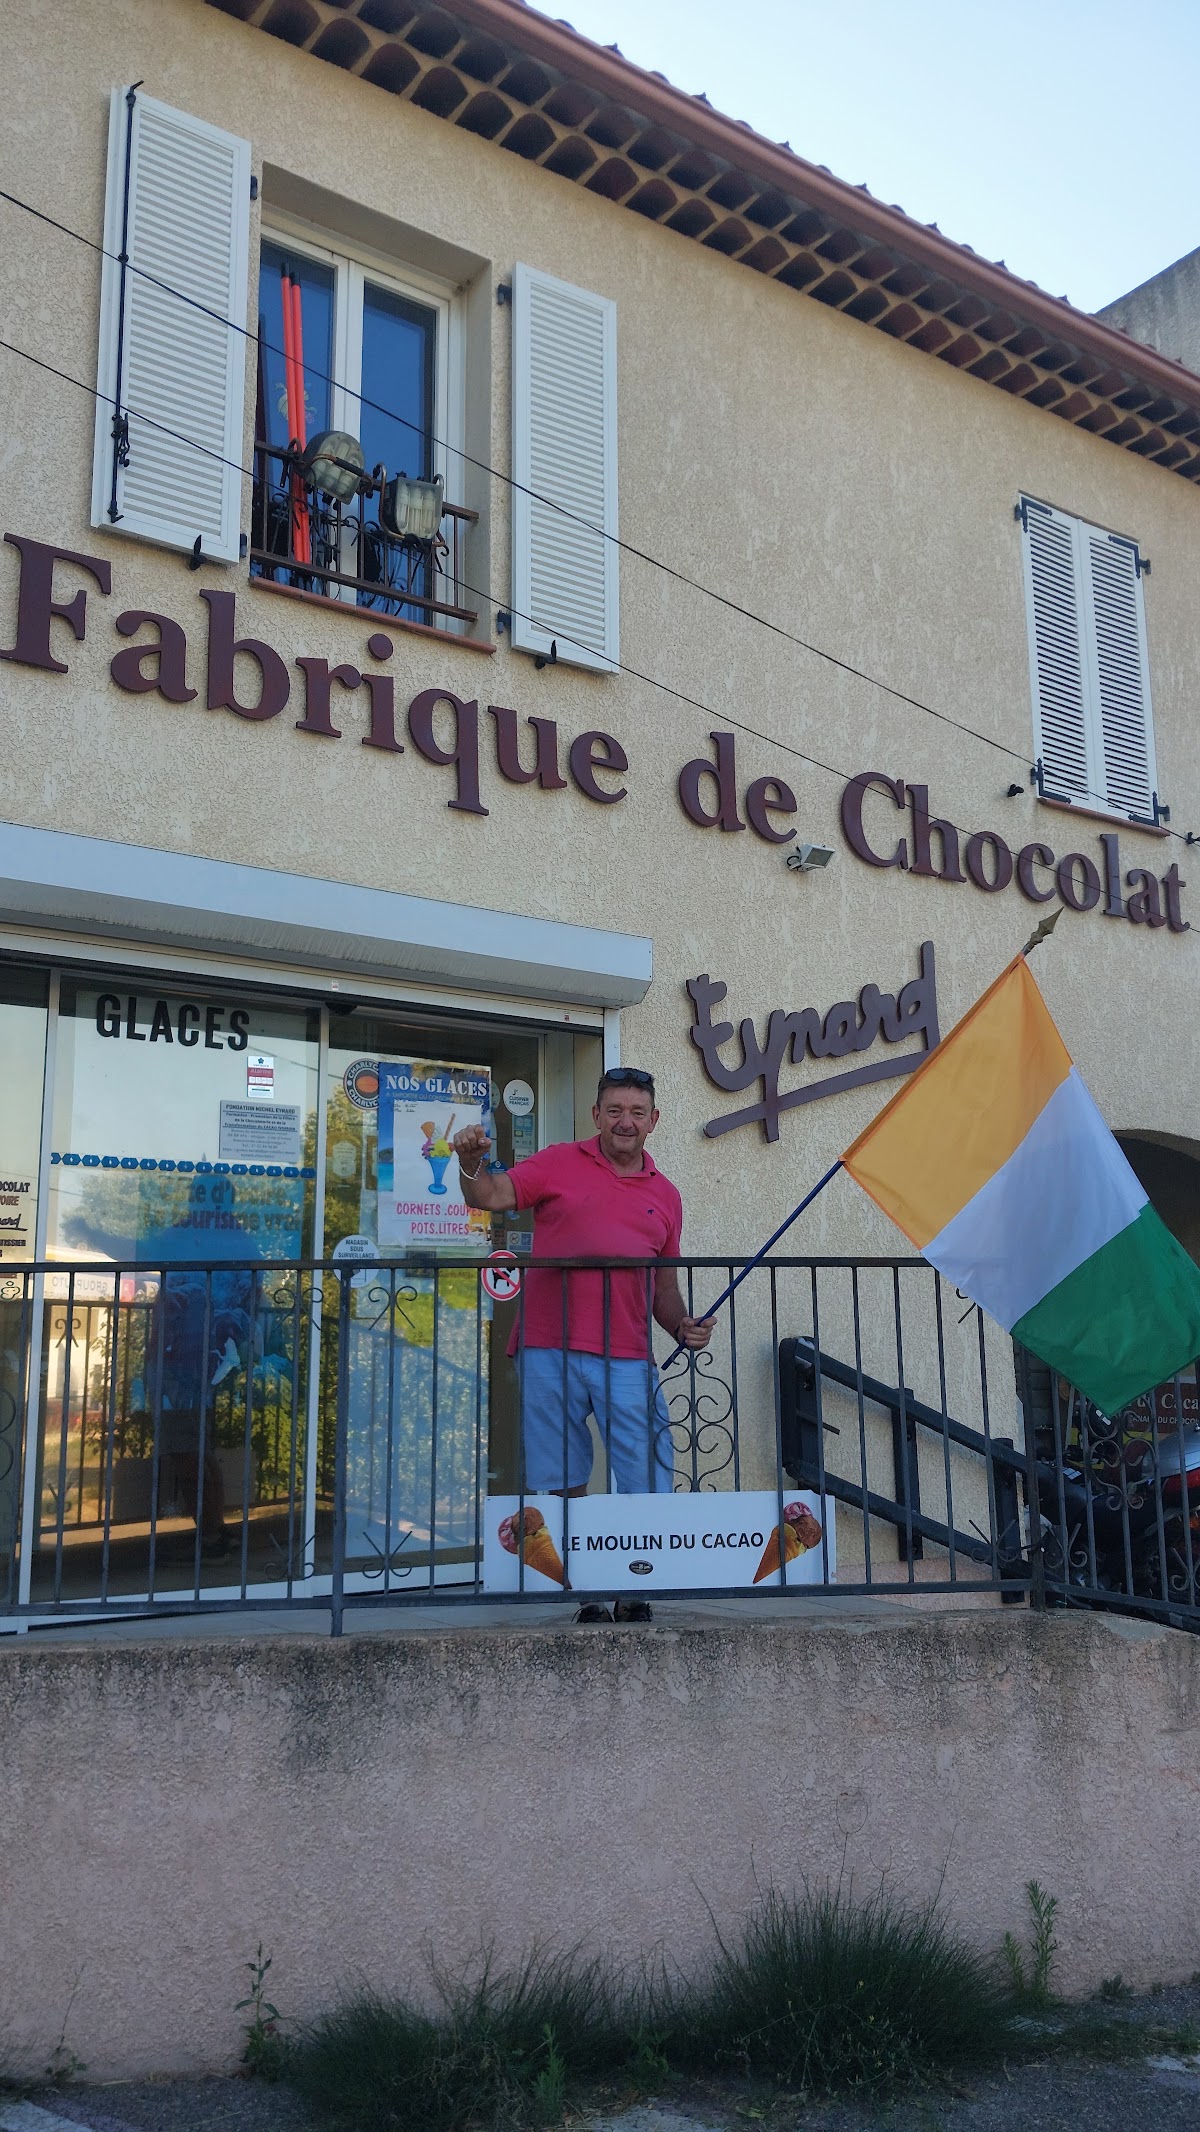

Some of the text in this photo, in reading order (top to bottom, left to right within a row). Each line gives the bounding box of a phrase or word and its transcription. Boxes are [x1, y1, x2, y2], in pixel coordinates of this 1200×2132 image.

[0, 533, 1191, 932] Fabrique de Chocolat
[96, 993, 250, 1052] GLACES
[385, 1074, 488, 1097] NOS GLACES
[396, 1203, 440, 1216] CORNETS
[411, 1222, 470, 1235] POTS.LITRES
[587, 1534, 663, 1551] MOULIN
[669, 1534, 696, 1550] DU
[701, 1532, 764, 1549] CACAO
